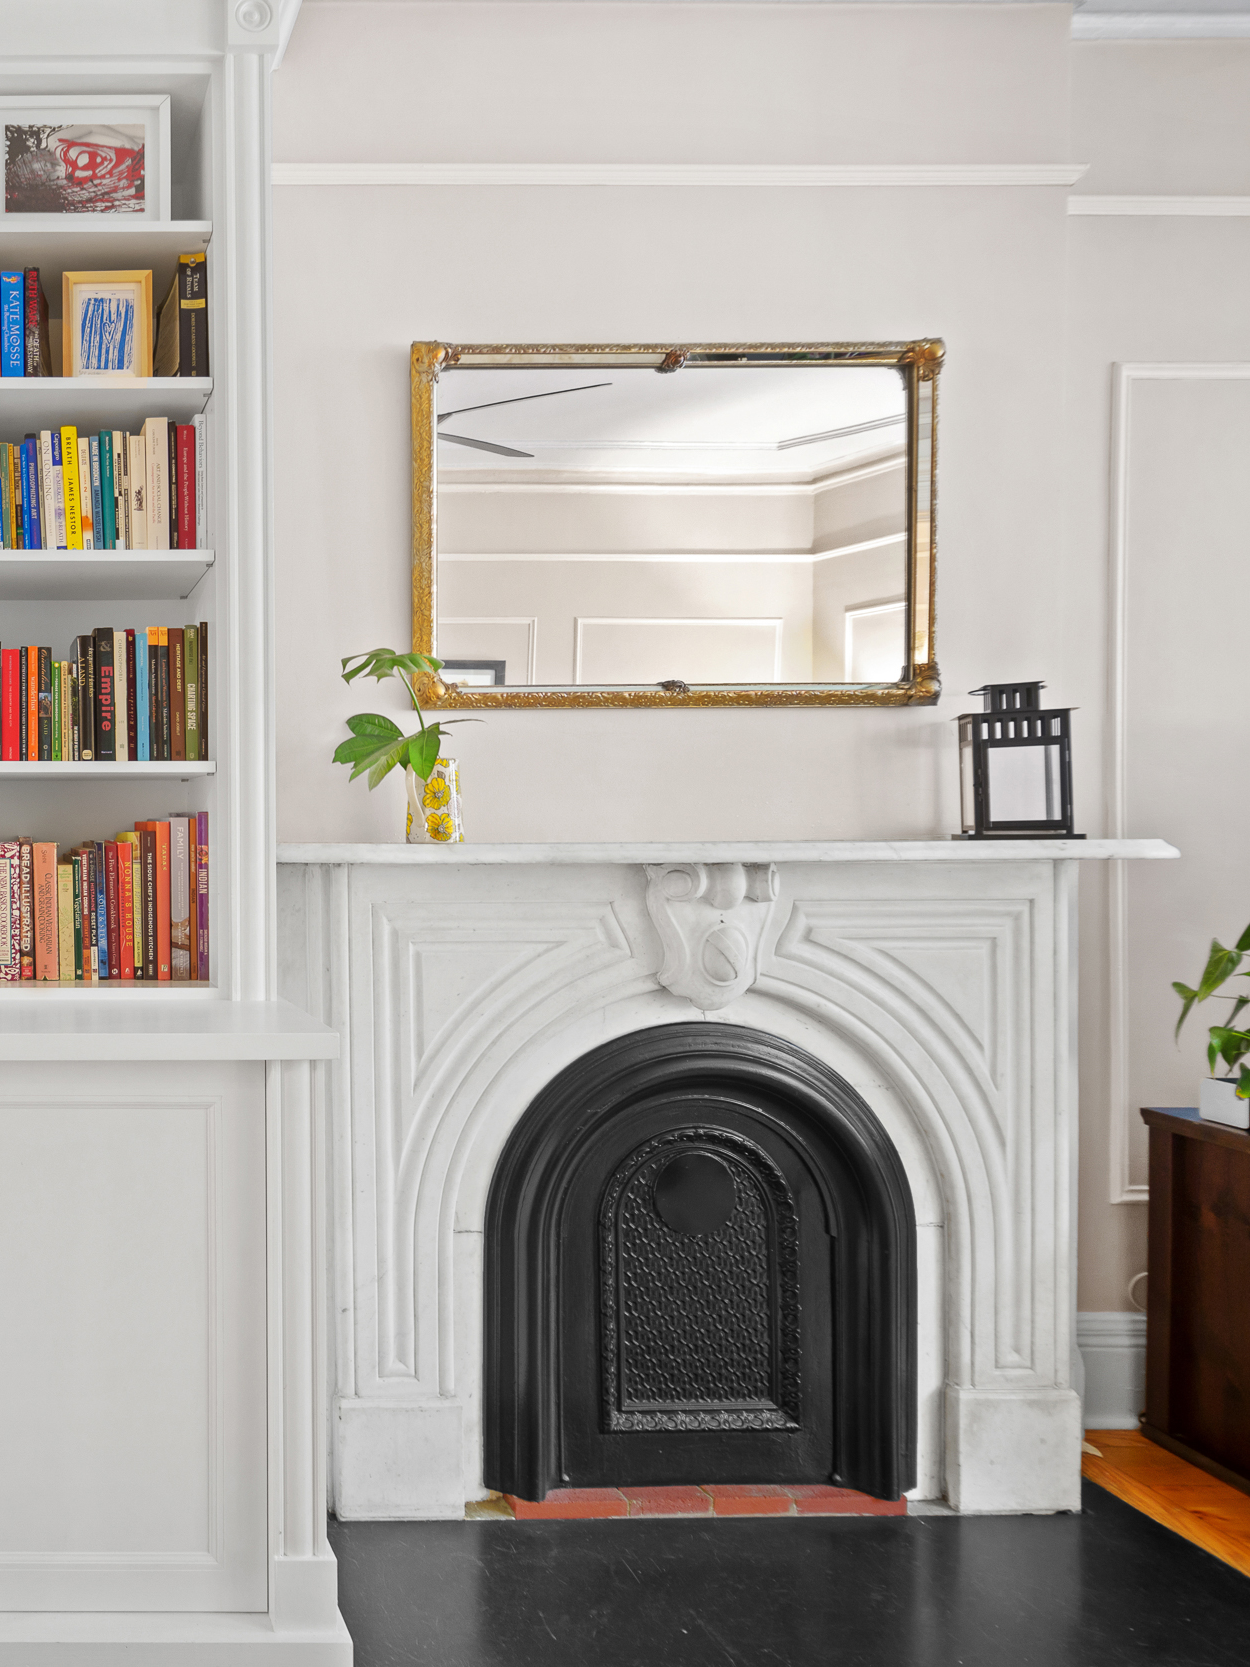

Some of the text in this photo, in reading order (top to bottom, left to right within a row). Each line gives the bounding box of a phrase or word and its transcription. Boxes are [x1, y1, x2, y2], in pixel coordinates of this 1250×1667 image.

[28, 271, 37, 328] RUTH WARE
[10, 291, 20, 368] KATE MOSSE
[43, 440, 52, 501] ON LONGING
[52, 433, 60, 461] Caponigro
[41, 650, 49, 690] Orientalism
[99, 666, 113, 731] Empire
[187, 683, 196, 730] CHARTING SPACE
[0, 891, 8, 912] BASICS
[22, 847, 30, 951] BREAD ILLUSTRATED
[199, 869, 207, 894] INDIAN
[0, 913, 8, 947] COOKBOOK
